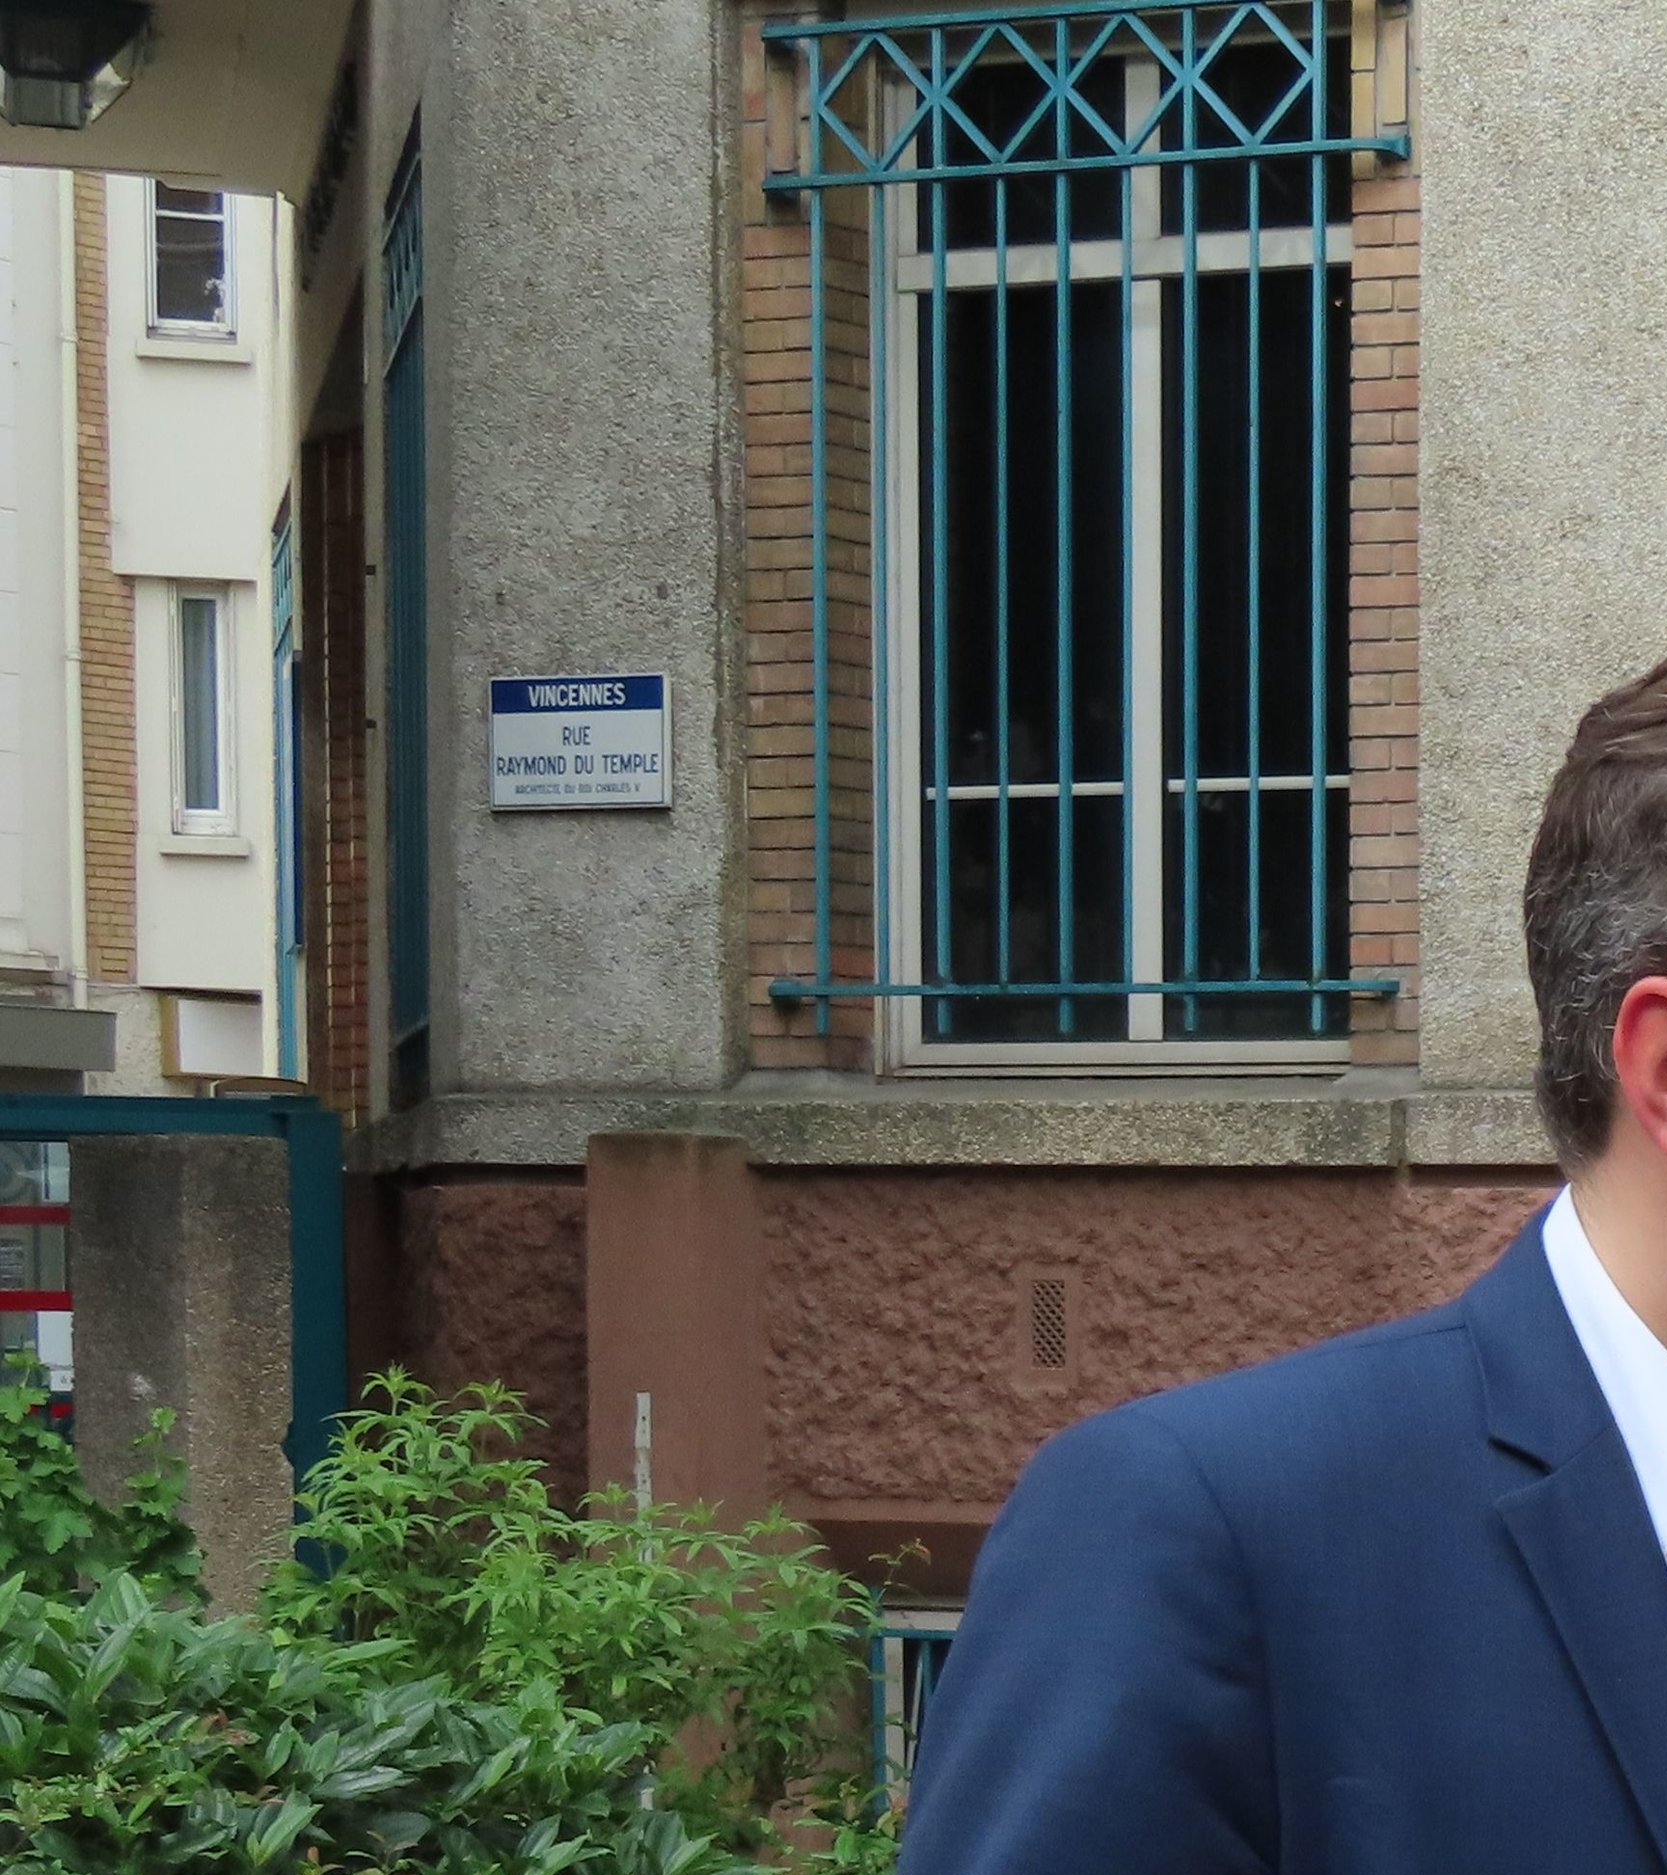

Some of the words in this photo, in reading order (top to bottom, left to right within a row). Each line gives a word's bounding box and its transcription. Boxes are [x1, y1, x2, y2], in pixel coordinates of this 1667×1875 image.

[528, 682, 627, 708] VINCENNES
[562, 726, 592, 747] RUE
[496, 755, 567, 777] RAYMOND
[574, 754, 594, 775] DU
[602, 753, 659, 775] TEMPLE
